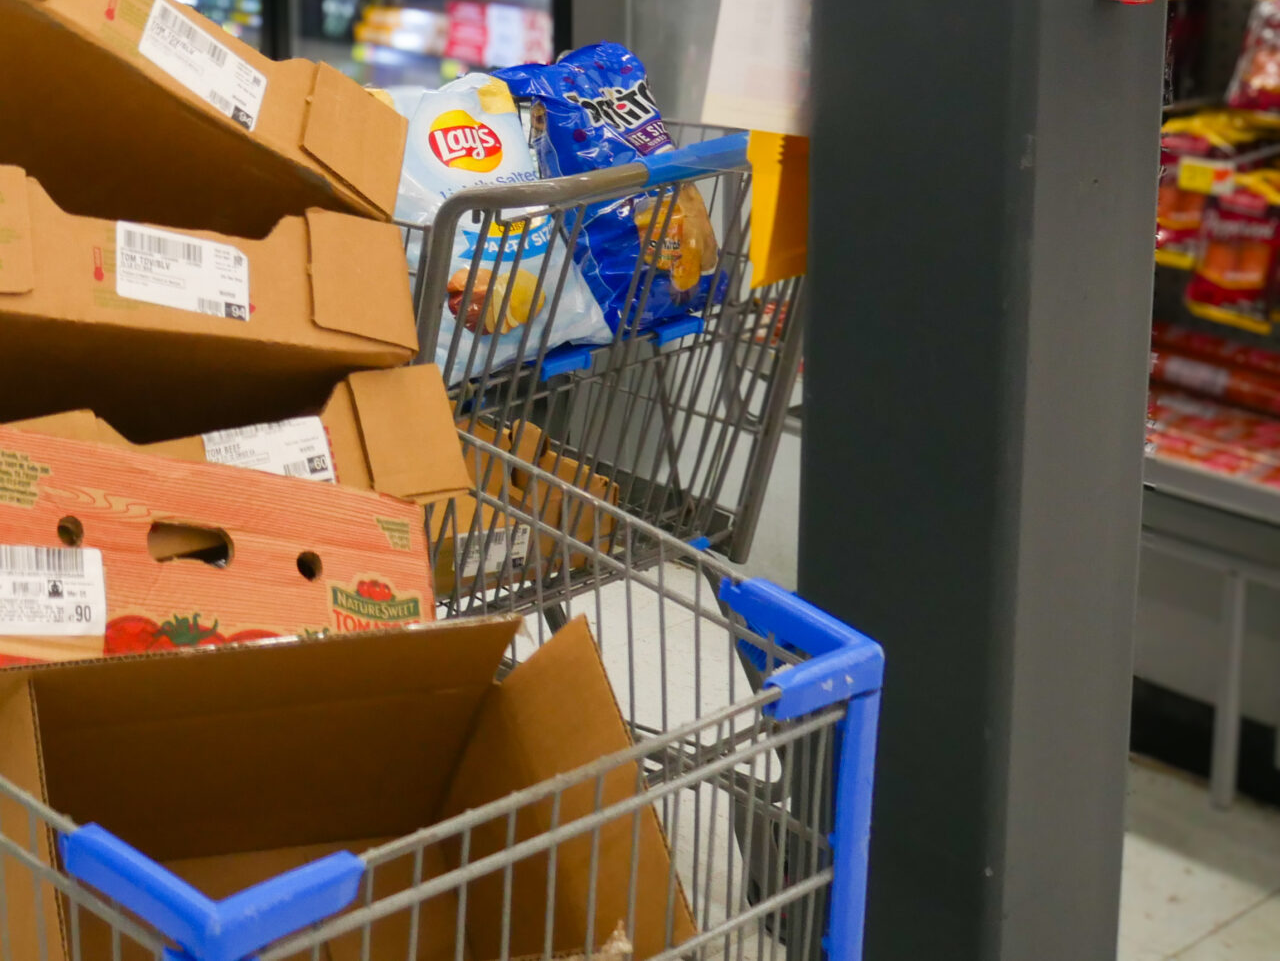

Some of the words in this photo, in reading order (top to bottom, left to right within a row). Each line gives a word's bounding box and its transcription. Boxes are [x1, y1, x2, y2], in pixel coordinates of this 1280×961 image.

[434, 125, 496, 160] Lay's
[531, 223, 553, 247] SIZ
[120, 252, 137, 264] TOM
[231, 306, 245, 319] 94
[207, 448, 222, 459] TOM
[224, 443, 241, 455] BEEF
[313, 457, 328, 471] 60
[336, 590, 415, 618] NATURESWEET
[75, 605, 91, 622] 90
